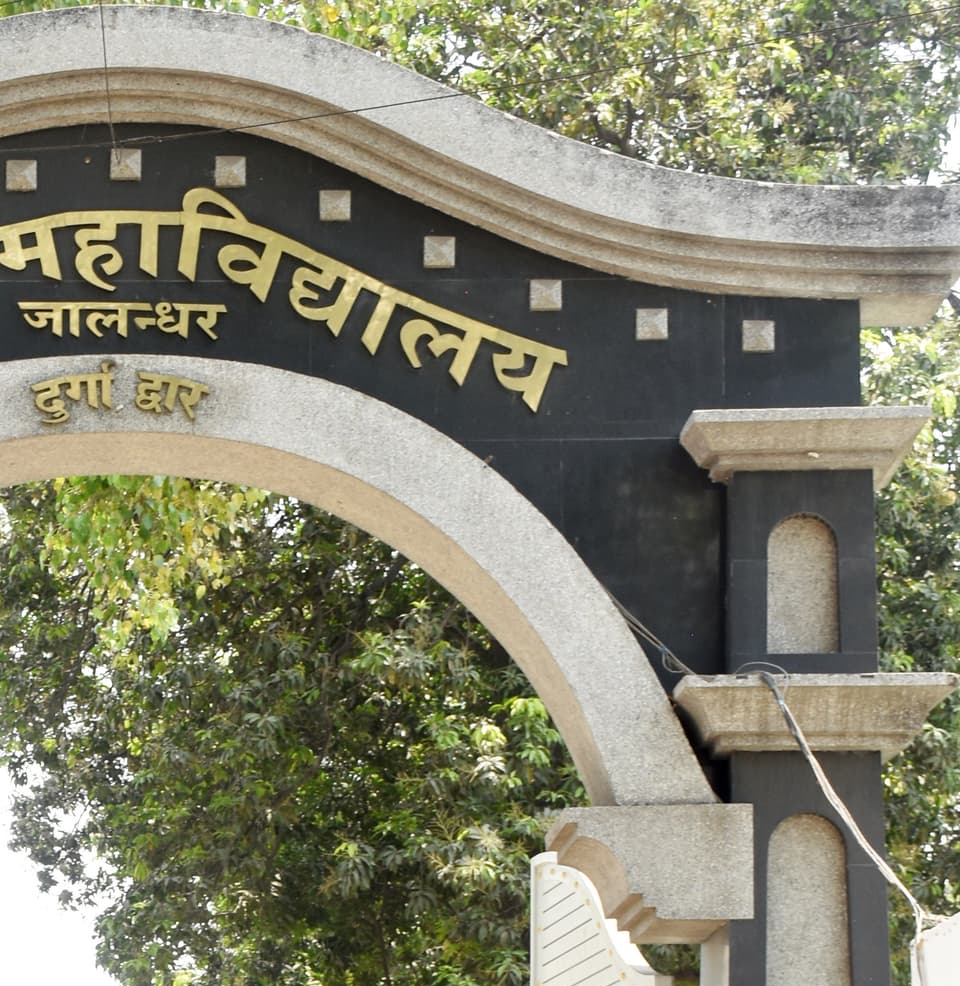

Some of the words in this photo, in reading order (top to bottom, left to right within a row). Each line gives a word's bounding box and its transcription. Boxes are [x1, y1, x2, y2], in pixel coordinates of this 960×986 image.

[18, 302, 228, 340] जालन्धर
[30, 360, 115, 424] दुर्गा
[135, 371, 210, 420] द्वार
